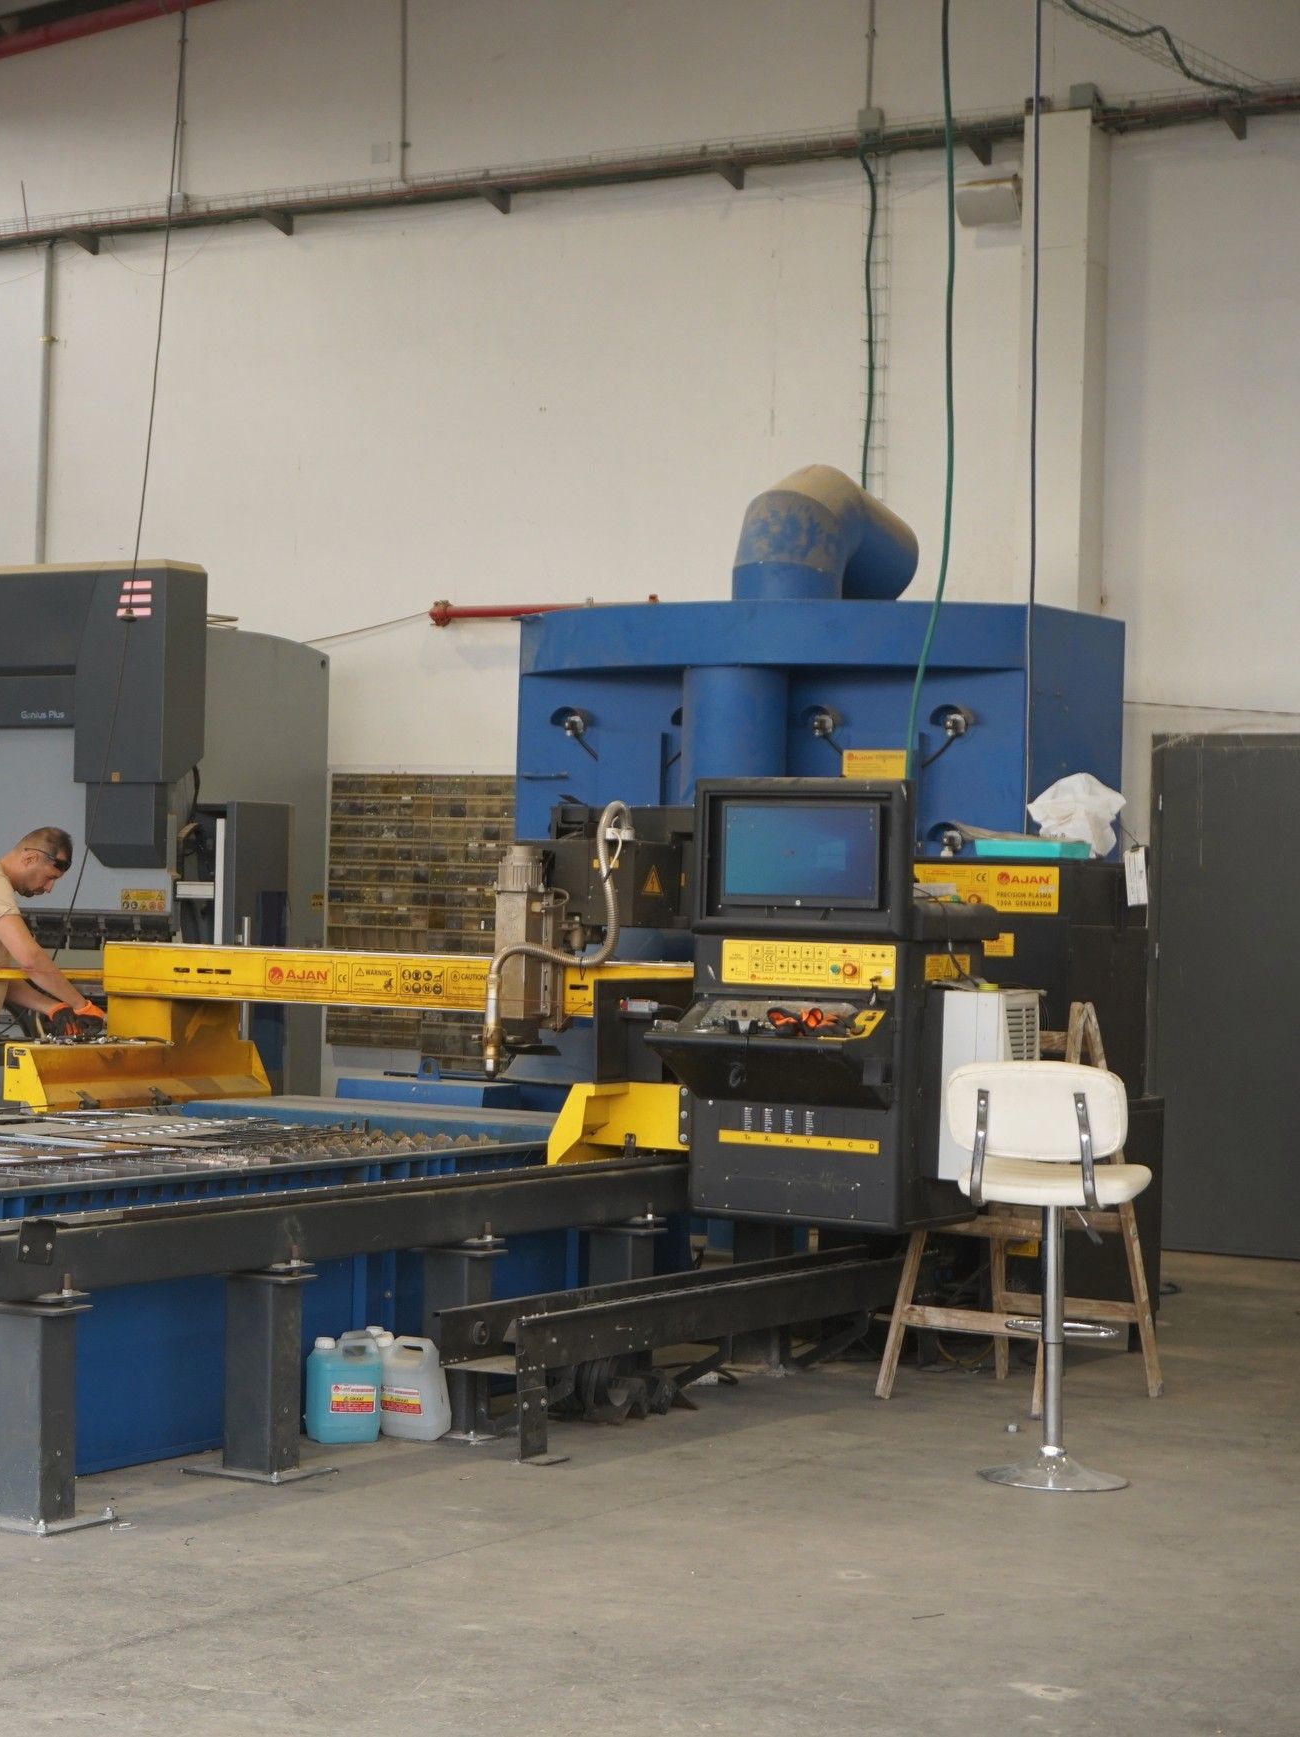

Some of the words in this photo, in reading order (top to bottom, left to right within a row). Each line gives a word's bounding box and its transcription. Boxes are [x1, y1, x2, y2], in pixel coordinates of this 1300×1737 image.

[20, 710, 47, 719] Genius
[48, 710, 66, 719] Plus
[975, 872, 987, 883] CE
[1010, 875, 1050, 884] AJAN
[286, 969, 328, 981] AJAN
[365, 969, 393, 977] WARNING
[337, 973, 348, 984] CE
